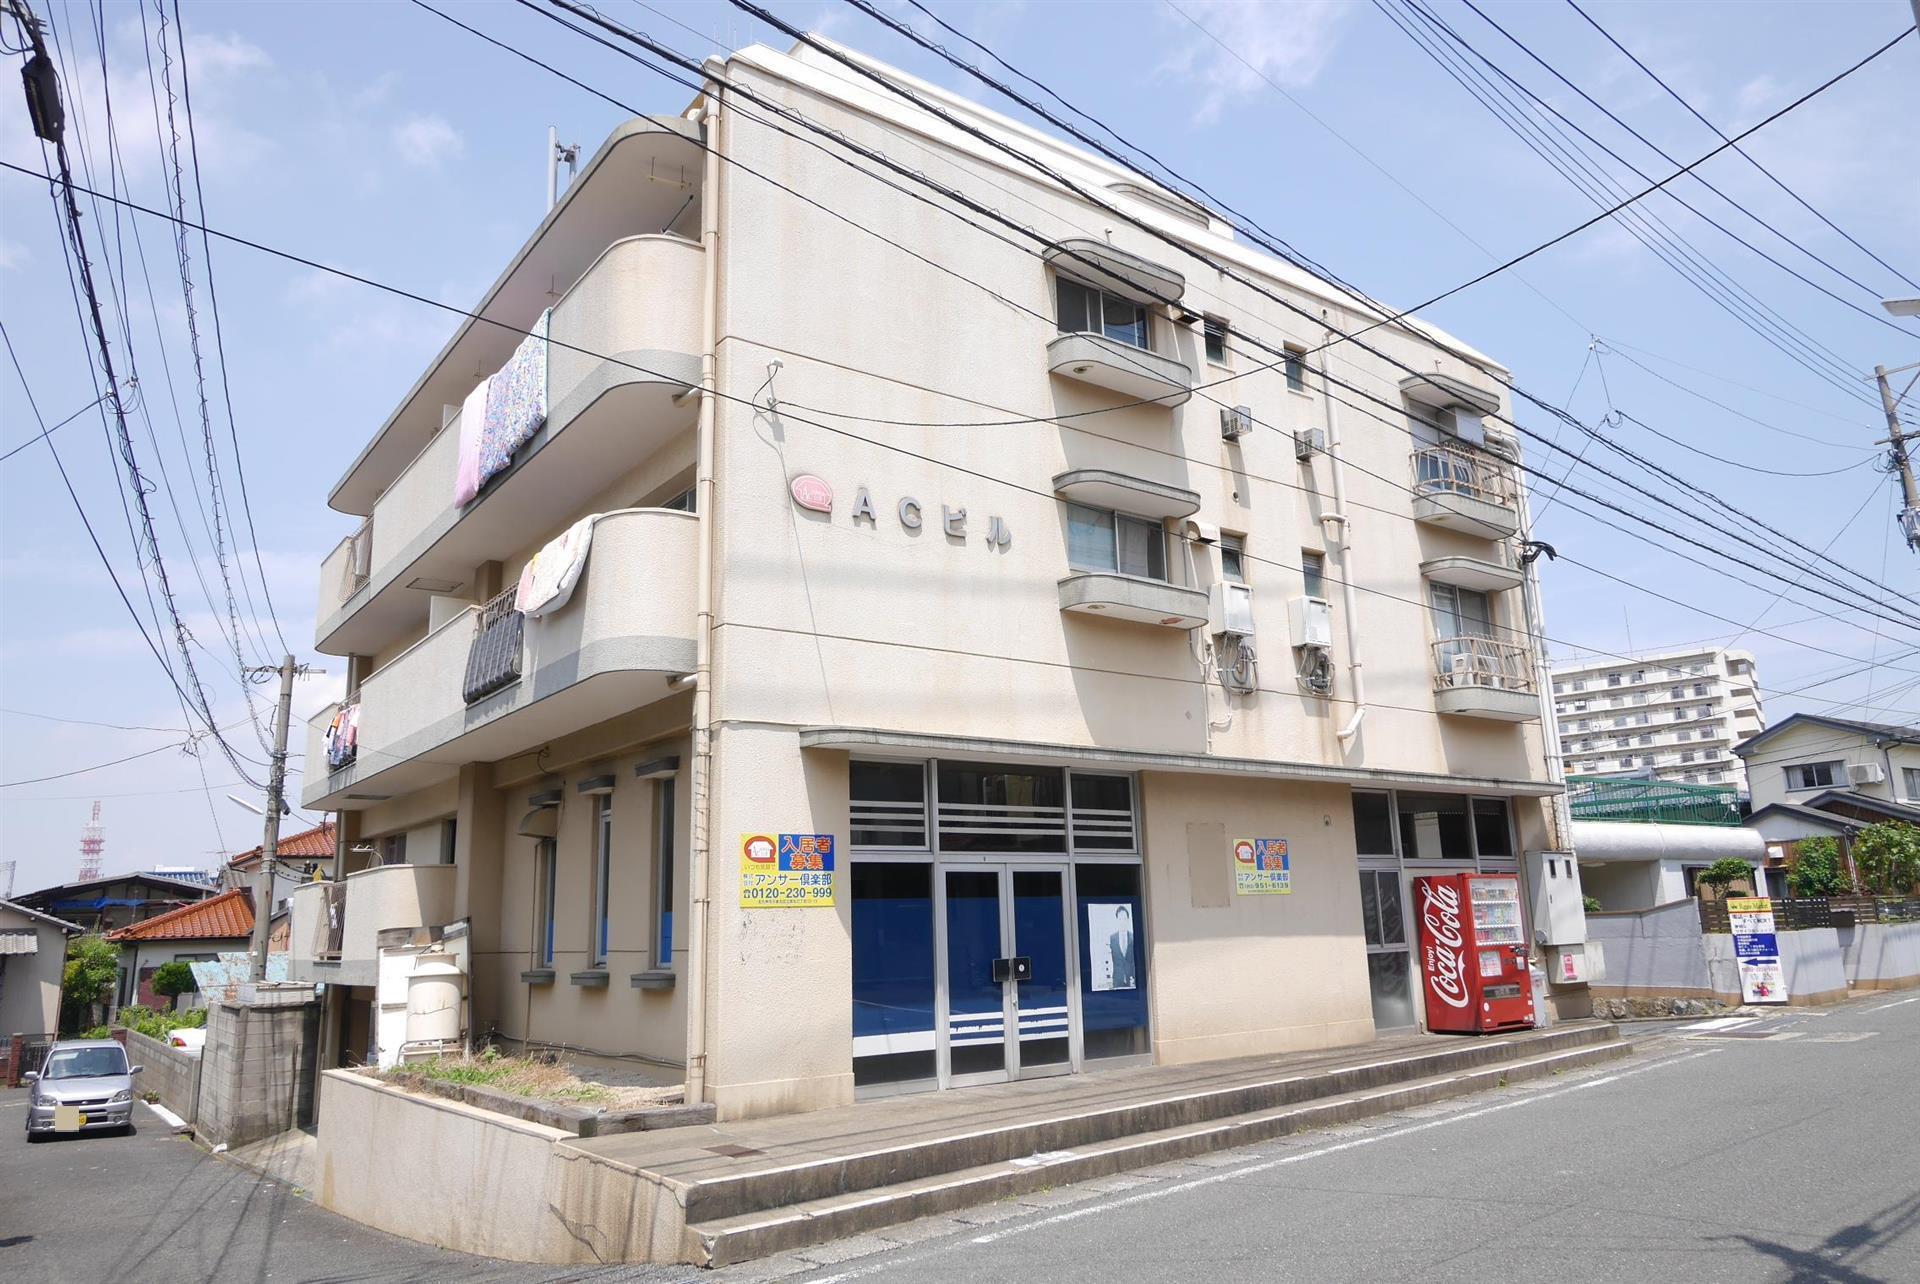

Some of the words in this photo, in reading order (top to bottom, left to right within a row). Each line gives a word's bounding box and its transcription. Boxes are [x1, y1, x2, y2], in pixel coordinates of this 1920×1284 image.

[781, 836, 831, 854] 入居者
[790, 853, 824, 870] 募集
[755, 873, 832, 886] アンサー倶楽部
[752, 887, 832, 898] 0120-230-999
[1421, 879, 1469, 1008] Coca-Cola
[1426, 945, 1435, 972] Enjoy!
